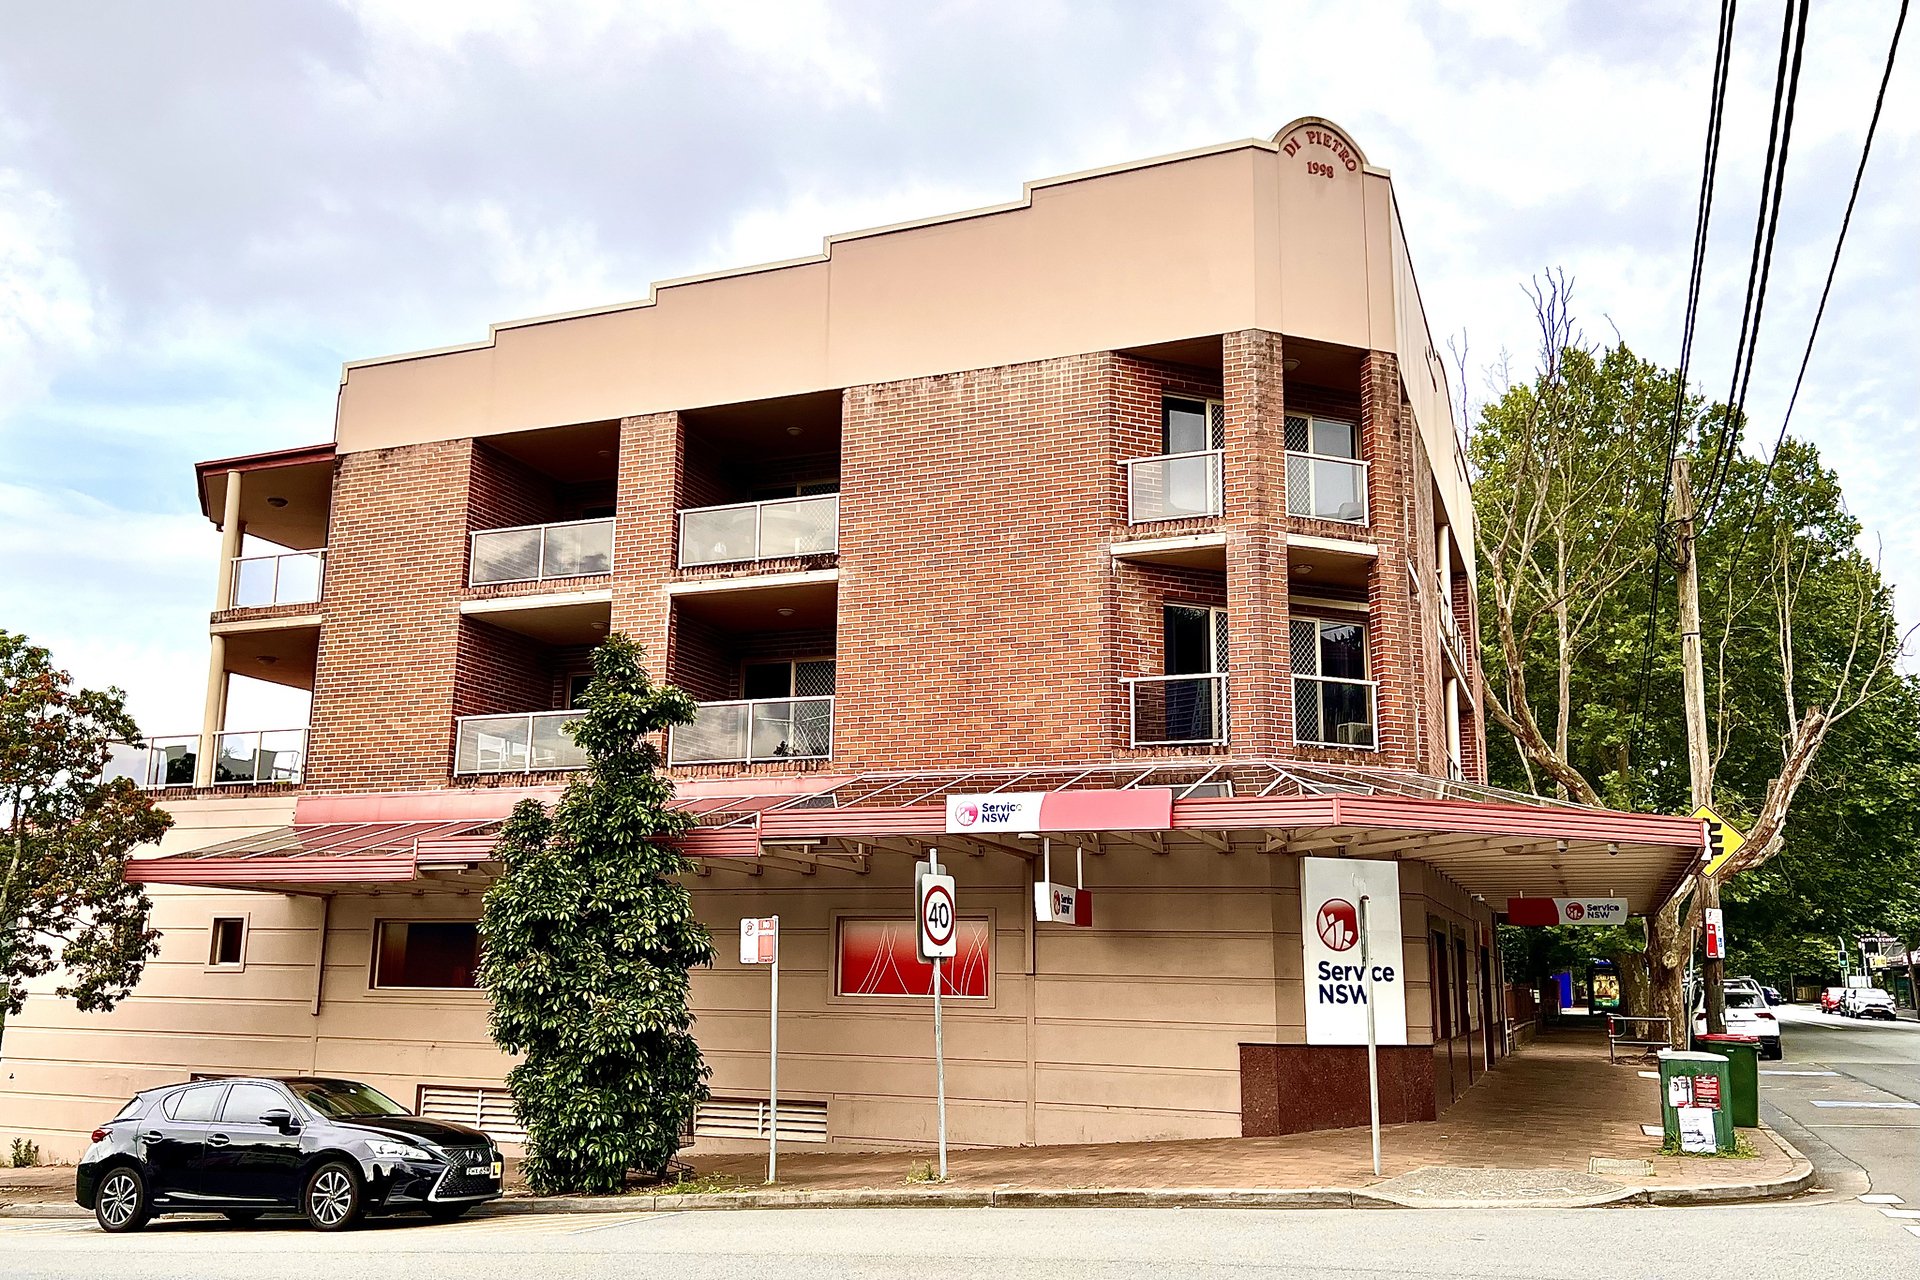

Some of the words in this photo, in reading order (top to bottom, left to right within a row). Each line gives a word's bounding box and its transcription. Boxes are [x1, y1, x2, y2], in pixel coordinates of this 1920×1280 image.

[1283, 136, 1301, 158] DI
[1306, 130, 1357, 172] PIETRO
[1307, 160, 1334, 179] 1998
[981, 812, 1010, 823] NSW
[928, 902, 949, 928] 40
[1586, 903, 1619, 912] Service
[1587, 911, 1610, 919] NSW
[1318, 960, 1395, 982] Servce
